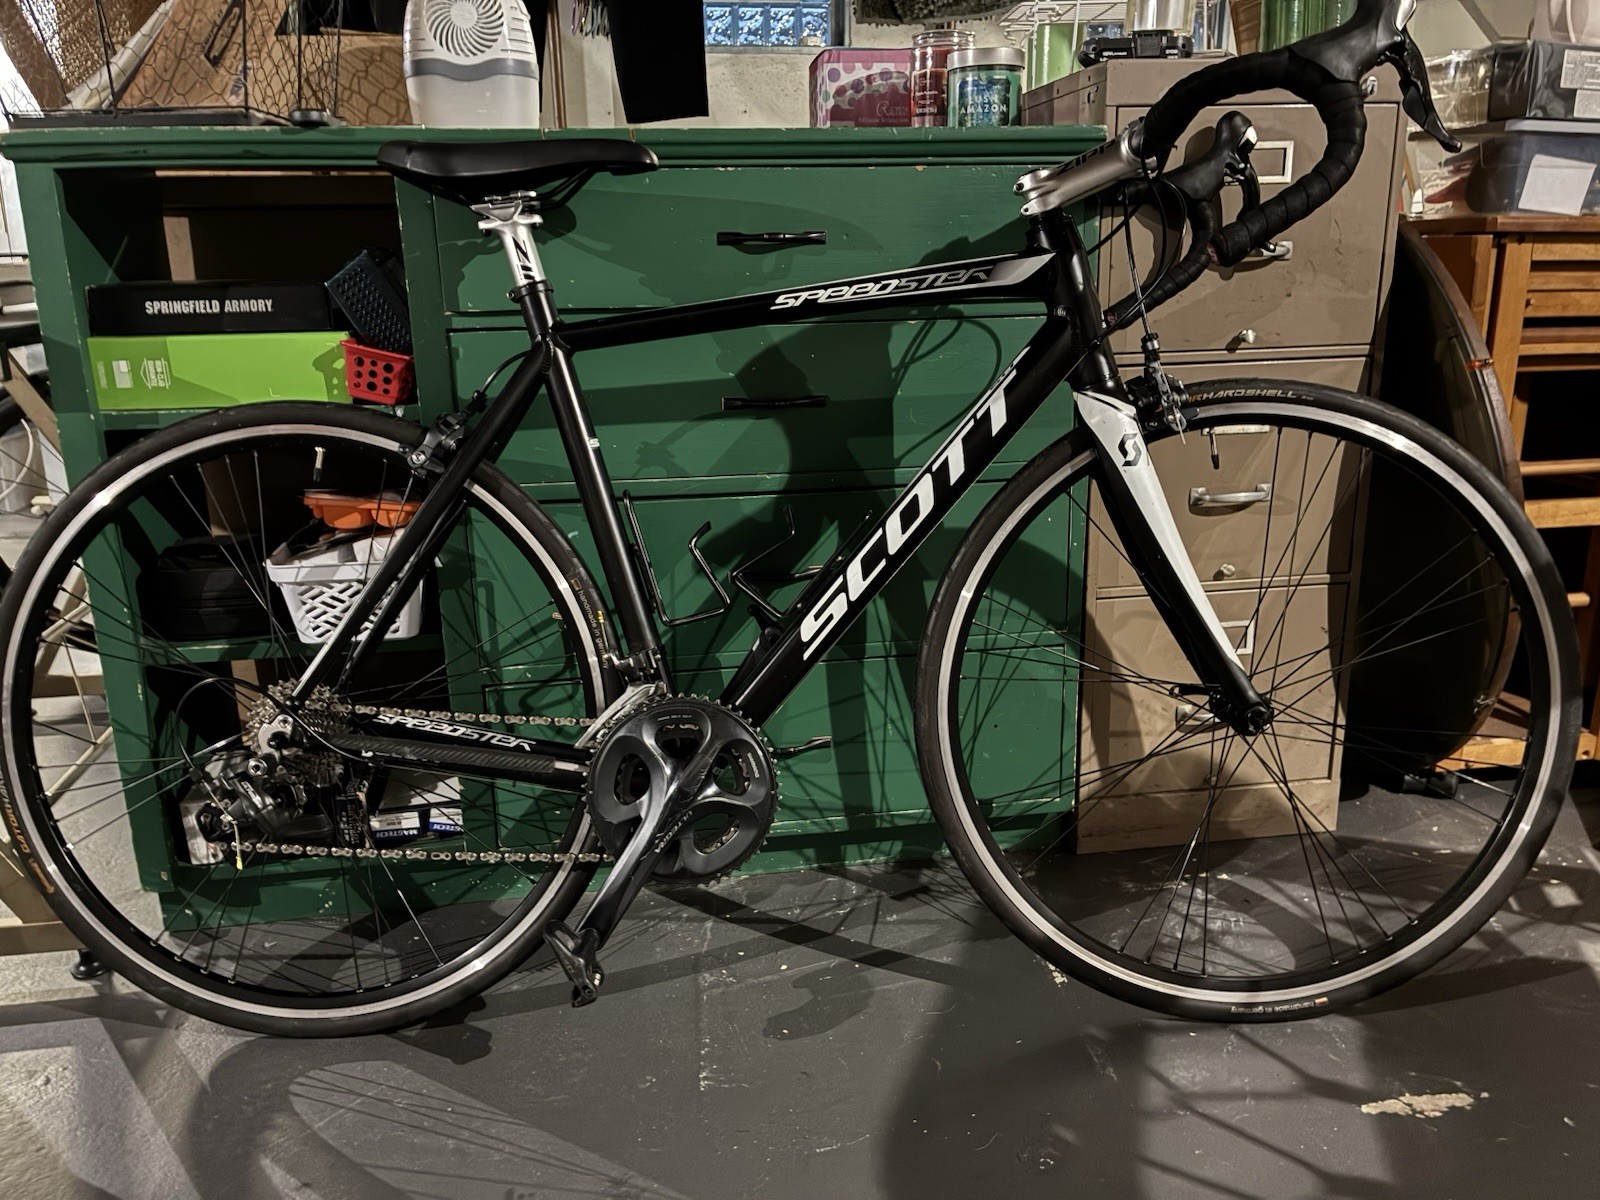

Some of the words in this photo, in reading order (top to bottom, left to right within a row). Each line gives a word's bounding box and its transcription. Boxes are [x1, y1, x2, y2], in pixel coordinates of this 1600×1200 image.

[960, 104, 1007, 114] AMAZON
[769, 266, 995, 310] SPEEDSTER
[145, 300, 221, 315] SPRINGFIELD
[224, 299, 273, 312] ARMORY
[800, 368, 1017, 661] SCOTT
[372, 714, 537, 751] SPEEDSTER
